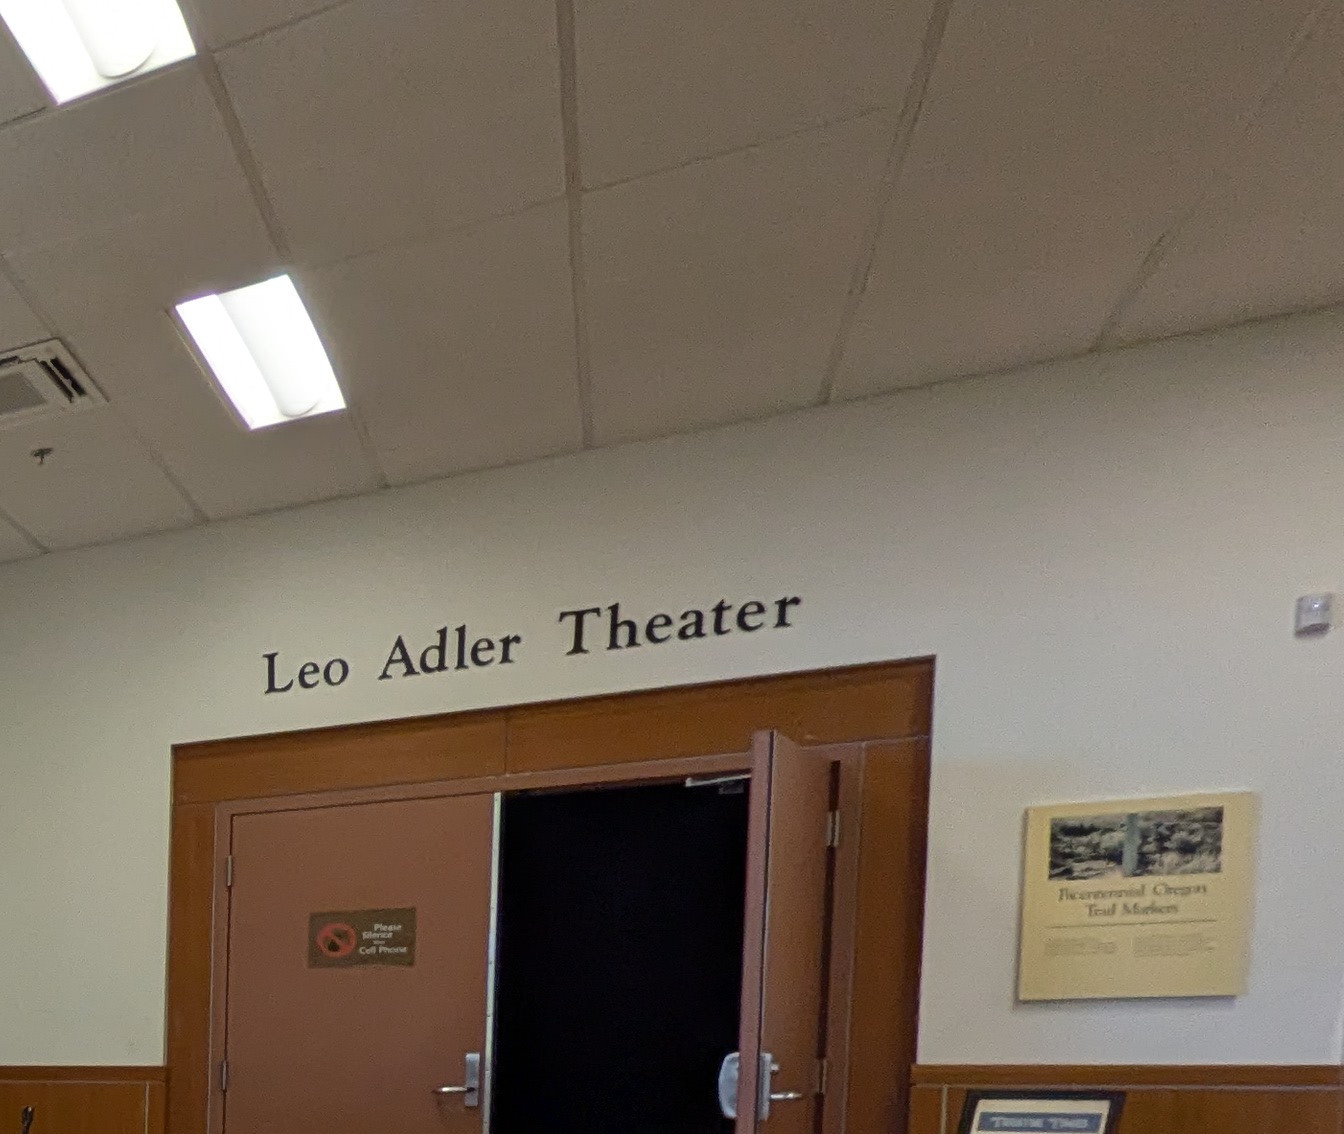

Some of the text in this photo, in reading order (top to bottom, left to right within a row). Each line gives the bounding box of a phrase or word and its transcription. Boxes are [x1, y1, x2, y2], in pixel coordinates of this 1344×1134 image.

[262, 593, 802, 695] Leo Adler Theater
[1153, 881, 1208, 897] Oregon
[1085, 902, 1117, 917] Trail
[374, 923, 402, 931] Please
[359, 946, 376, 955] Cell
